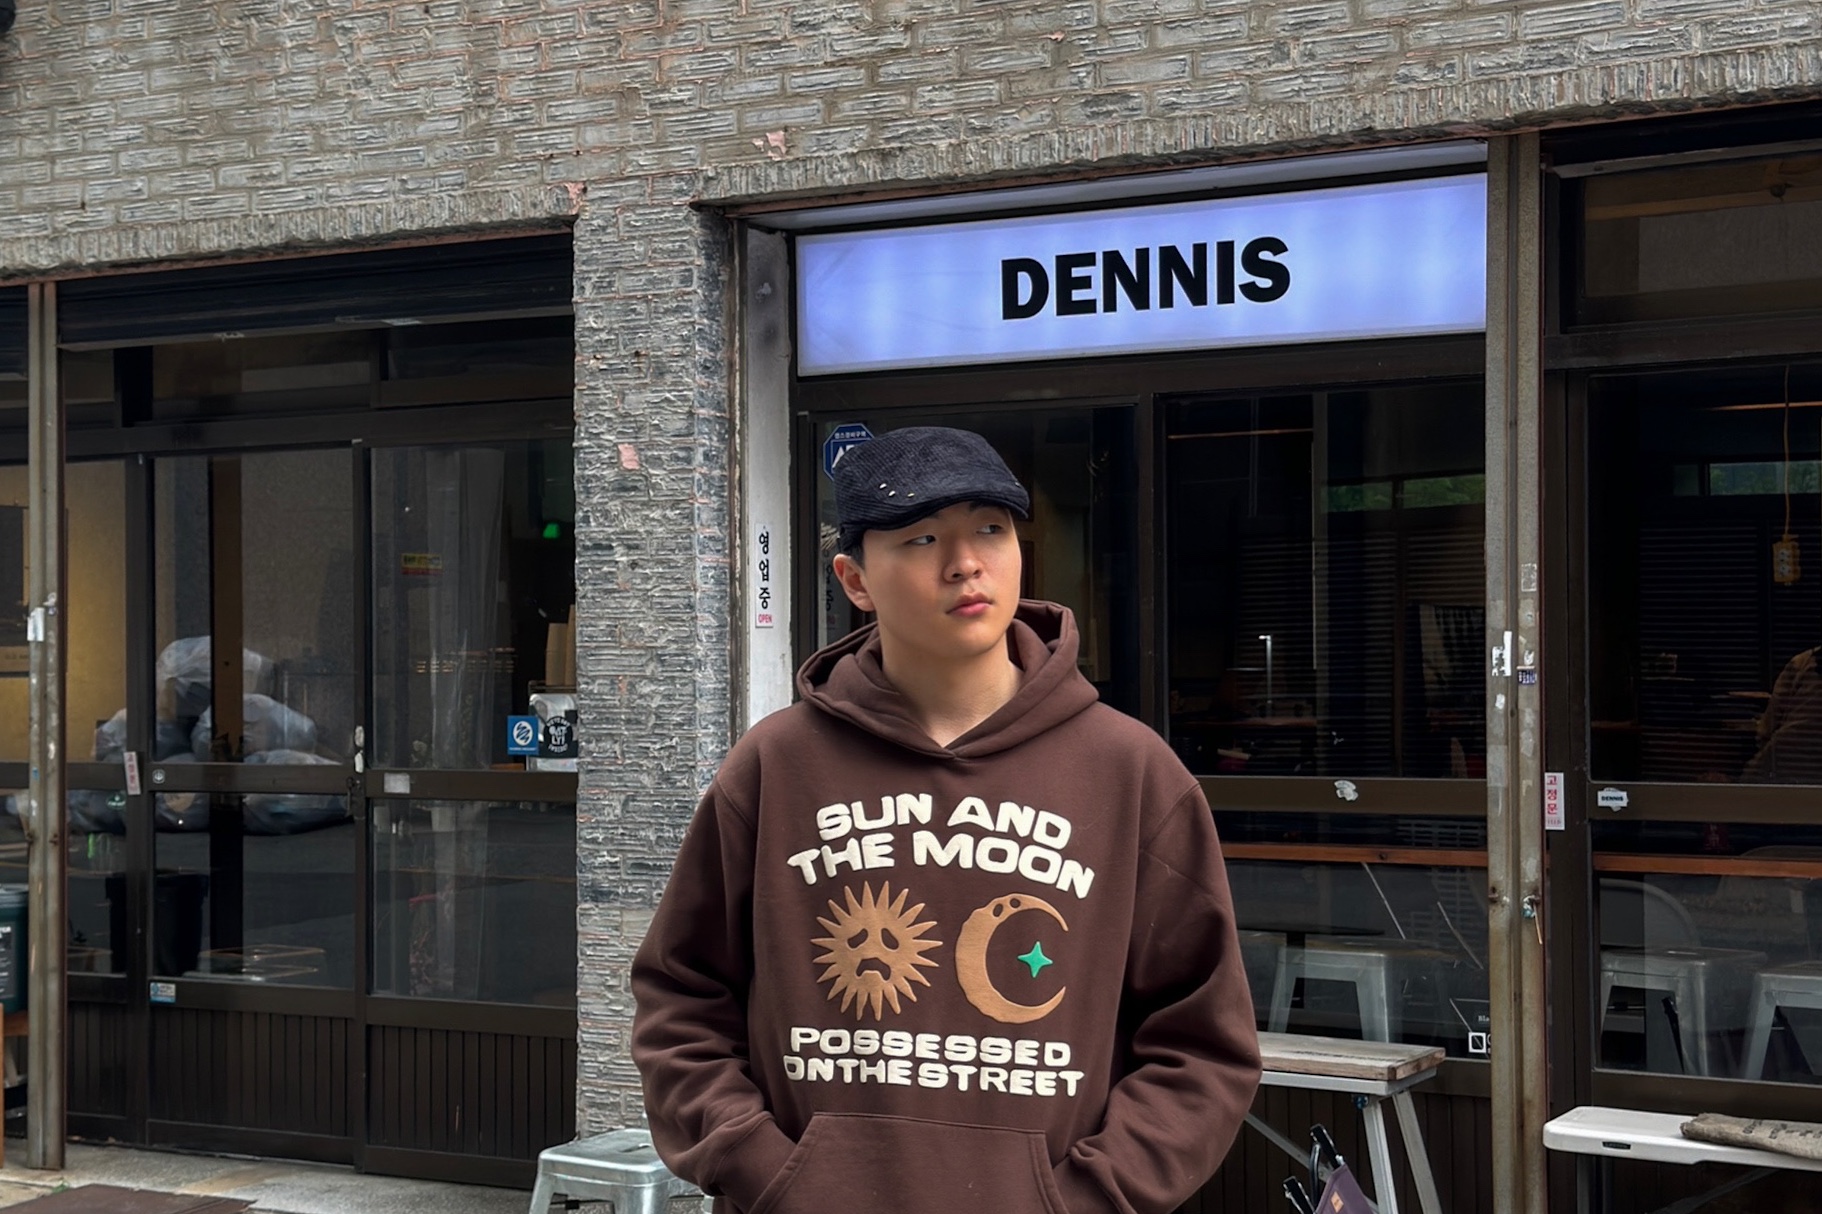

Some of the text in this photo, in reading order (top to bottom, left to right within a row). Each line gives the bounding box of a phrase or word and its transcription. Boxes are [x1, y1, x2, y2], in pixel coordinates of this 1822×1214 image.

[1001, 236, 1290, 320] DENNIS
[758, 531, 771, 610] 영업중
[758, 614, 773, 623] OPEN
[816, 793, 1072, 850] SUN AND
[1546, 775, 1558, 815] 고정문
[787, 830, 1095, 899] THE MOON
[790, 1027, 1071, 1067] POSSESSED
